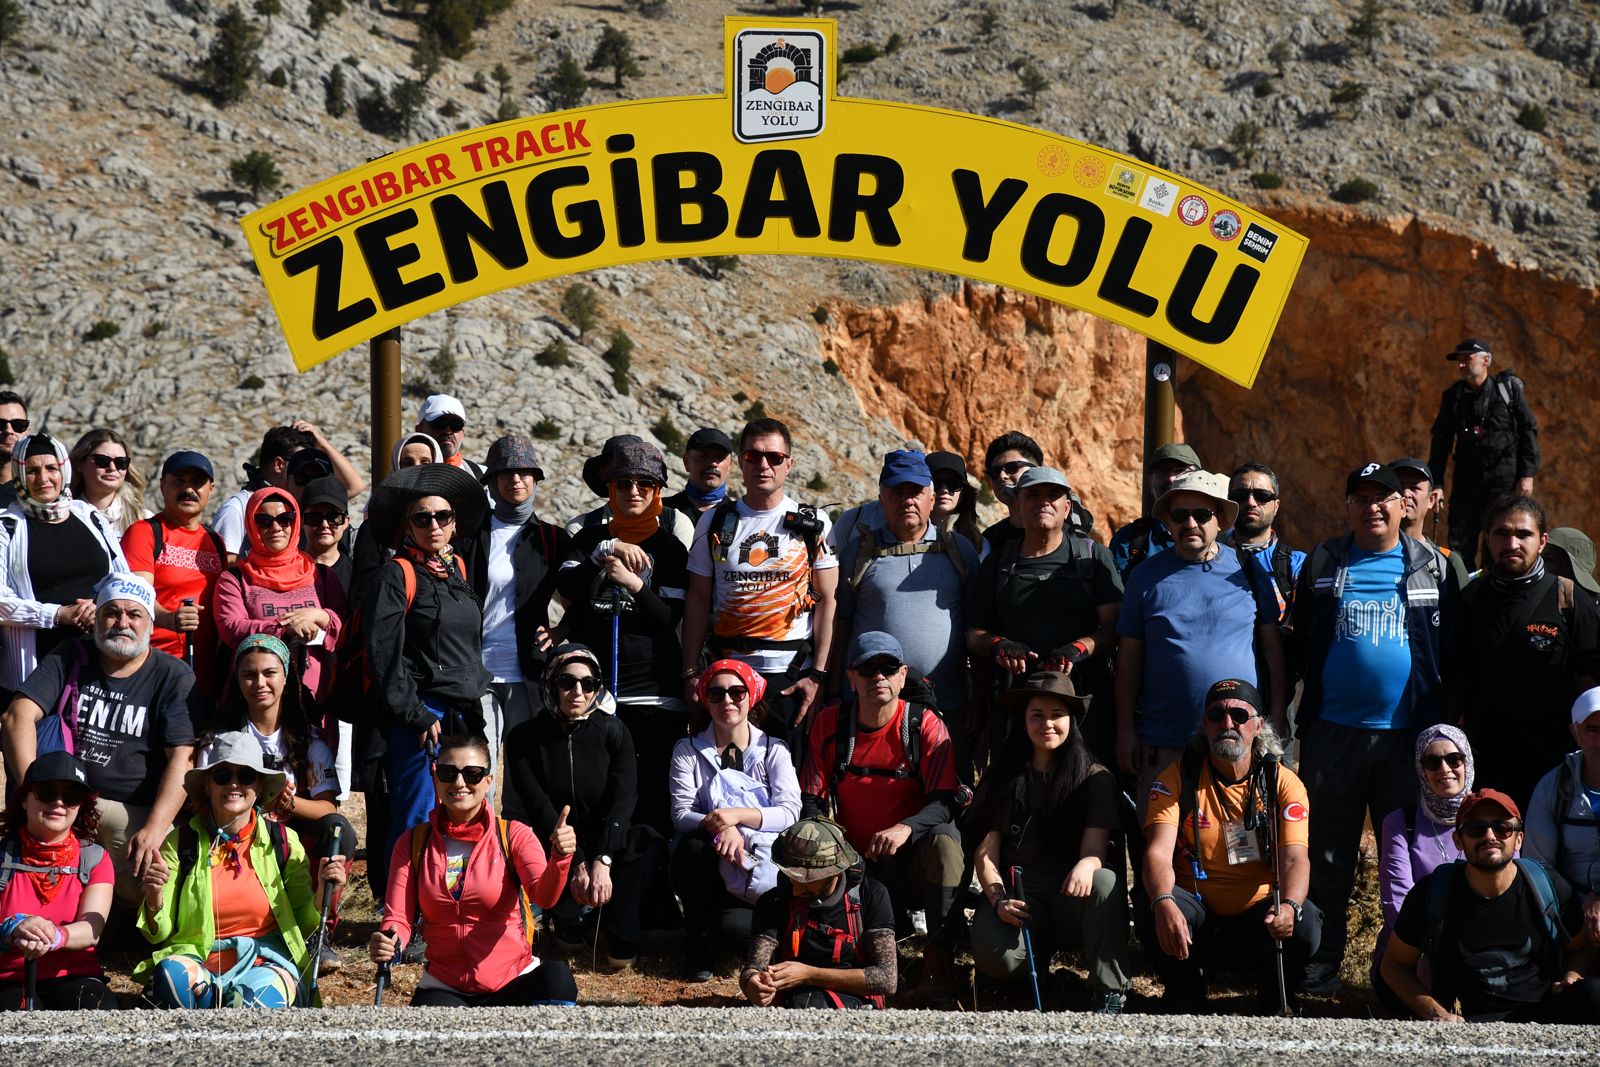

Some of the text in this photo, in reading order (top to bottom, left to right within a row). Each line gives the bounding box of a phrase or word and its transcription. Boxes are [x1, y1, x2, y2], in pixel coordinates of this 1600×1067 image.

[746, 100, 814, 112] ZENGIBAR
[761, 115, 799, 126] YOLU
[266, 119, 591, 251] ZENGIBAR TRACK
[282, 133, 1261, 345] ZENGİBAR YOLU
[1246, 230, 1273, 248] BENİM
[723, 570, 791, 582] ZENGIBAR
[739, 582, 772, 592] YOLU
[76, 693, 147, 738] ENIM
